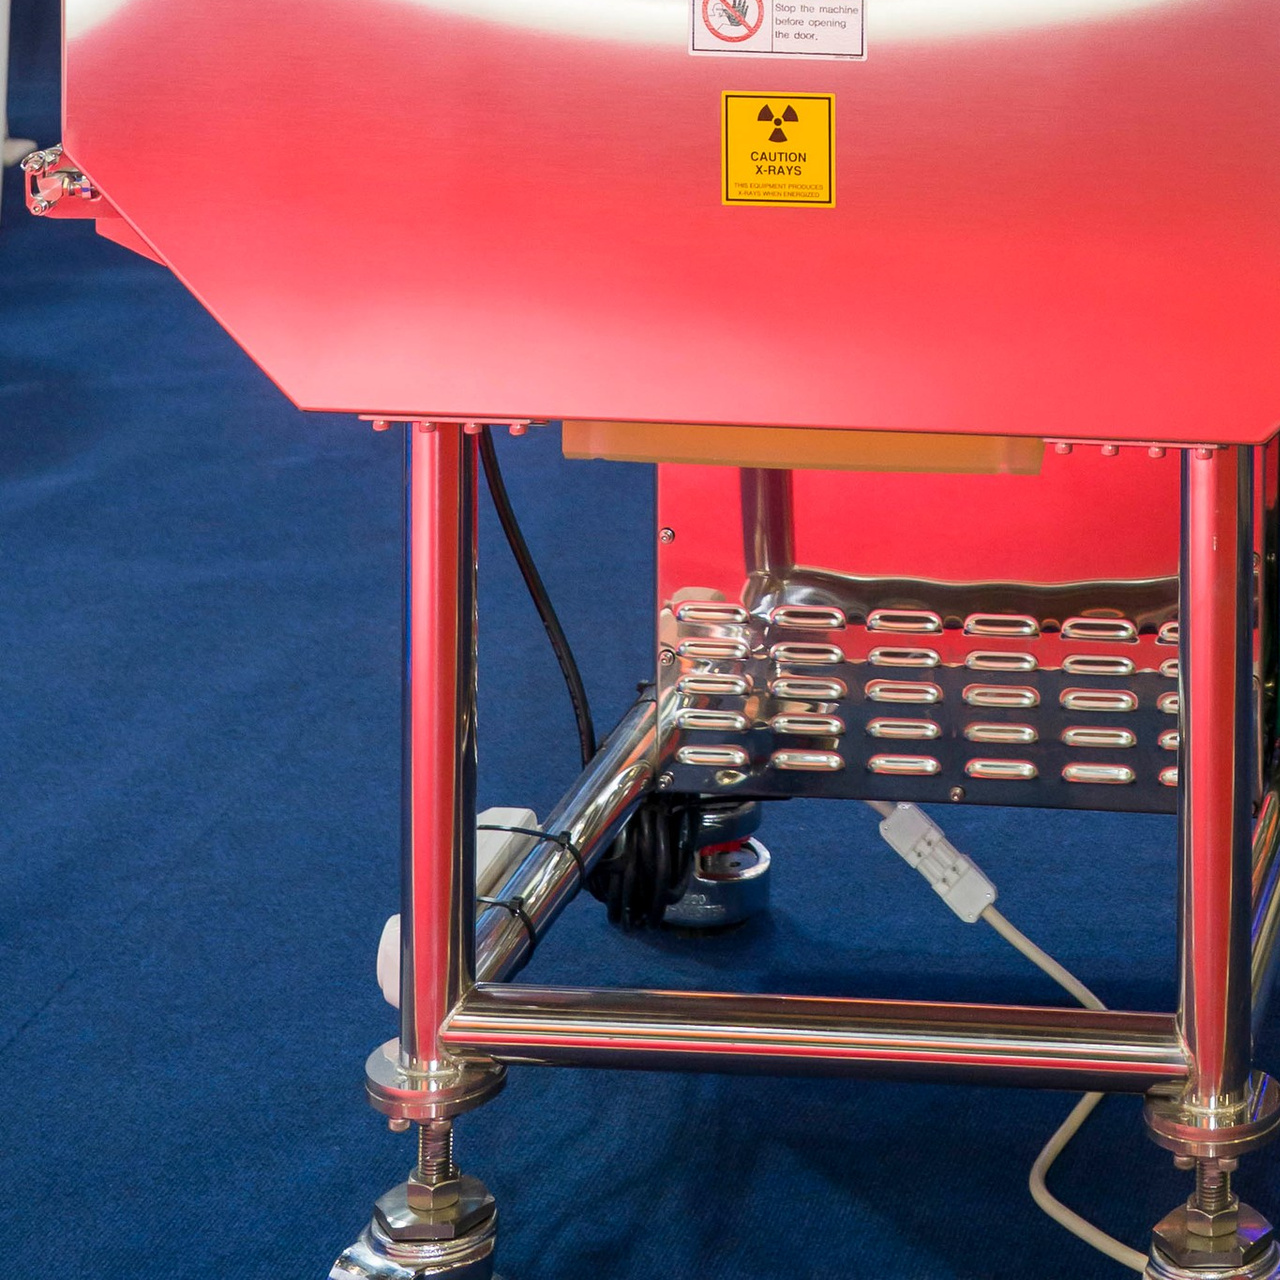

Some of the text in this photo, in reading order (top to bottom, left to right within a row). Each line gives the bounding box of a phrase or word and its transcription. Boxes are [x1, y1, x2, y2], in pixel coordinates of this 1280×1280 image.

[775, 3, 859, 15] Stop the machine
[775, 17, 847, 30] before opening
[775, 30, 818, 41] the door.
[750, 150, 807, 163] CAUTION
[755, 164, 802, 176] X-RAYS
[749, 182, 786, 190] EQUIPMENT
[788, 183, 824, 191] PRODUCES
